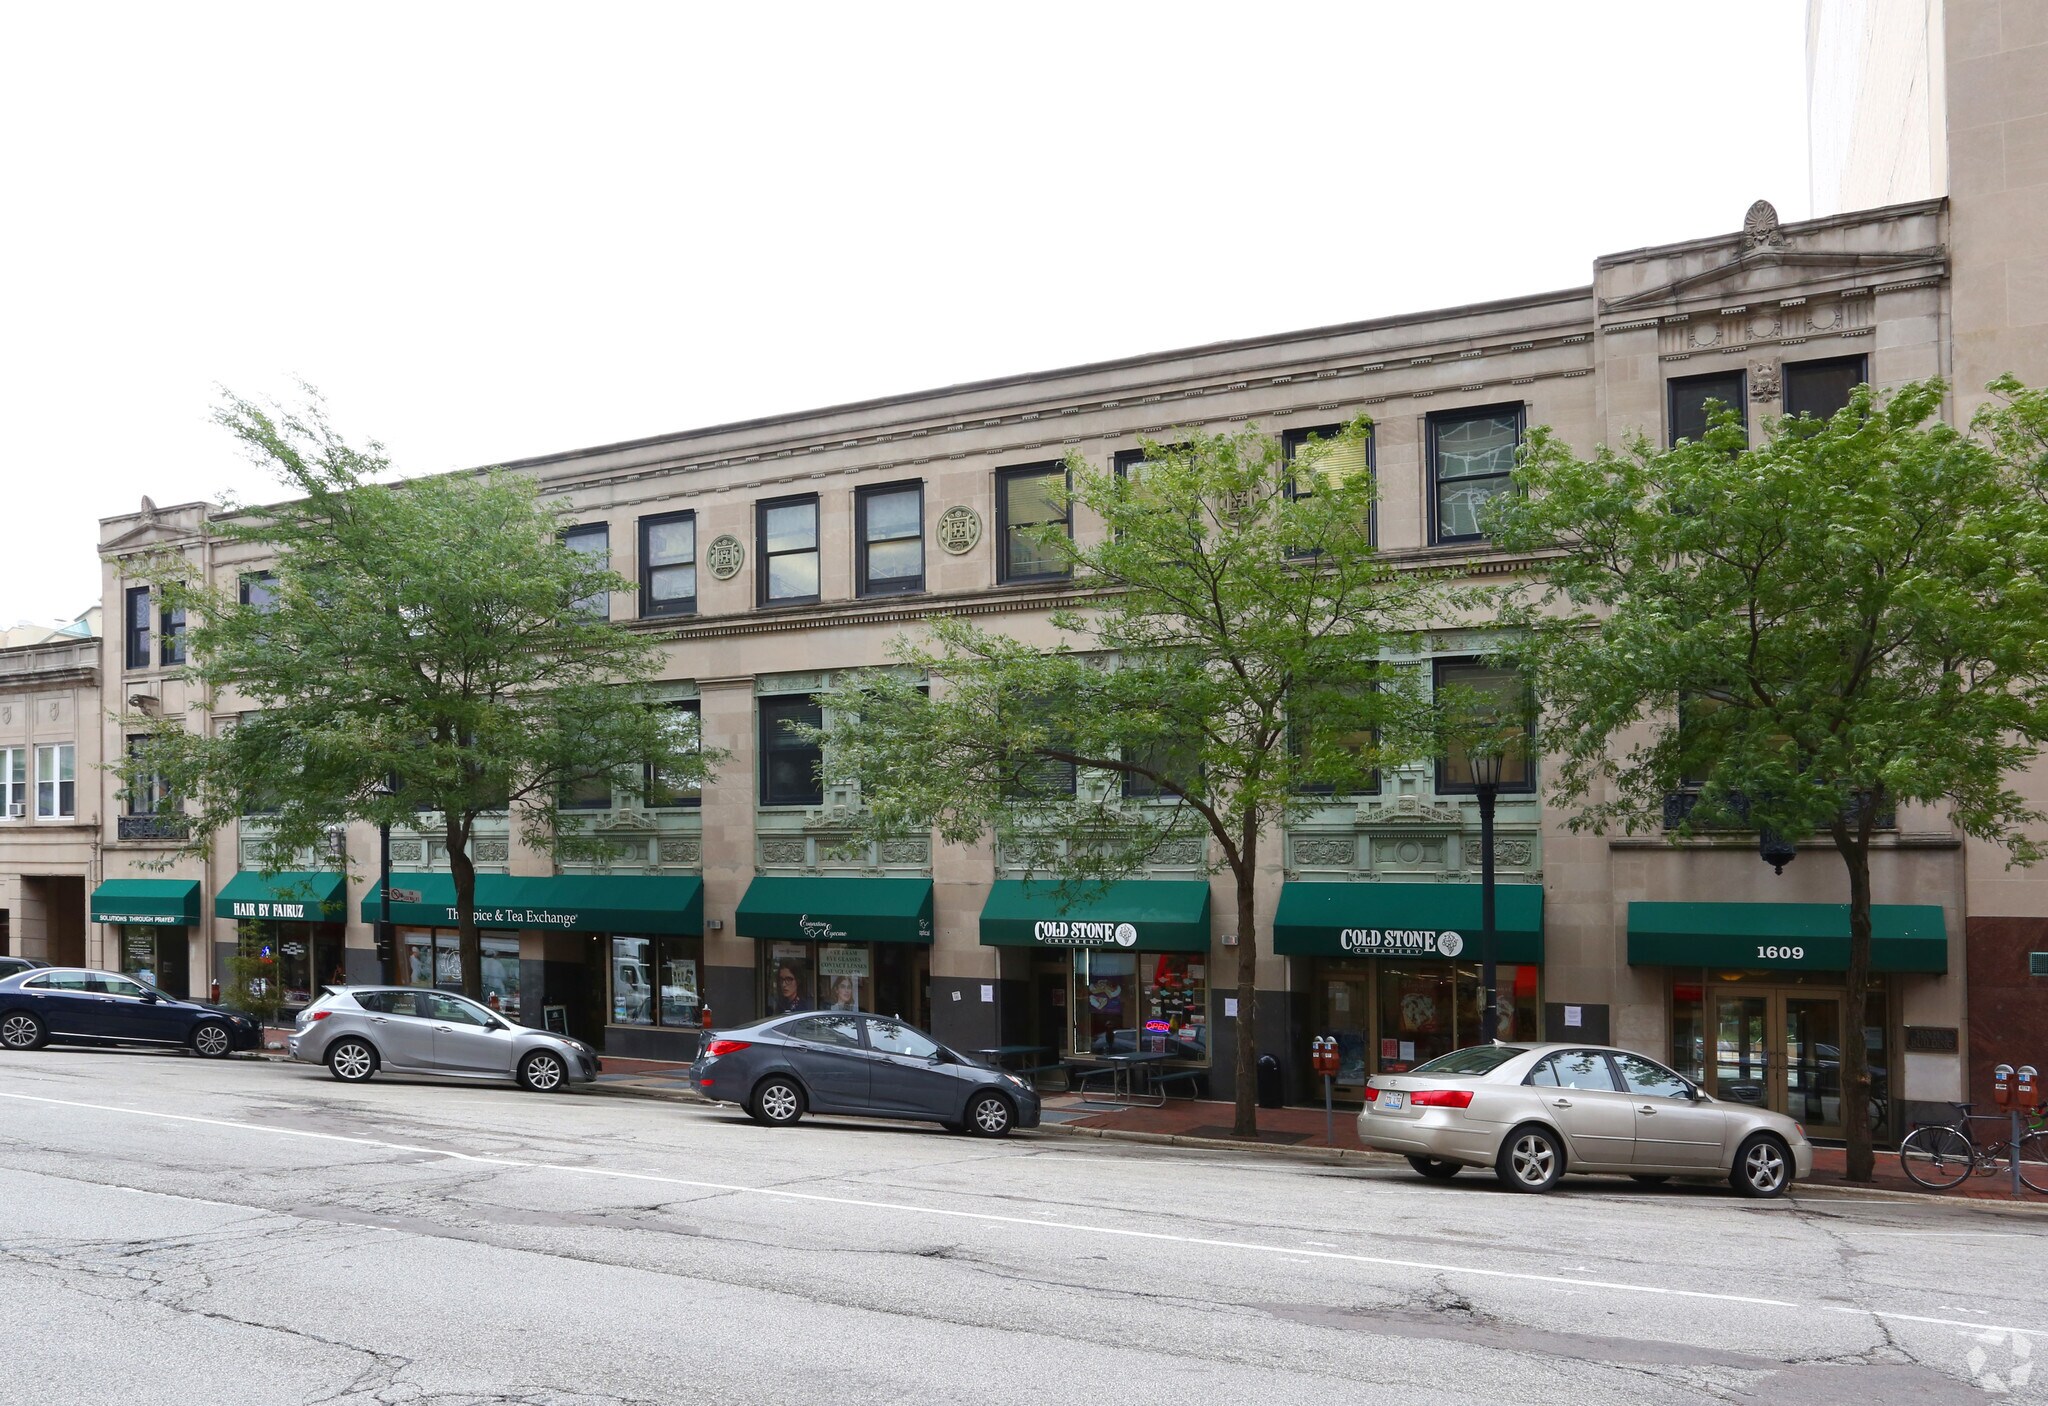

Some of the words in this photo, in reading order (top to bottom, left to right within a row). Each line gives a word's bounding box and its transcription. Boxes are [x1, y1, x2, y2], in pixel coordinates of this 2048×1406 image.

[233, 902, 256, 916] HAIR
[258, 903, 270, 917] BY
[273, 903, 304, 918] FAIRUZ
[446, 907, 459, 920] Th
[473, 909, 493, 924] pice
[505, 909, 524, 922] Tea
[526, 910, 576, 928] Exchange
[99, 914, 128, 922] SOLUTIONS
[128, 915, 154, 923] THROUGH
[799, 914, 827, 928] Evanston
[823, 923, 847, 938] Eyecare
[1034, 921, 1069, 941] COLD
[1070, 922, 1115, 943] STONE
[1340, 929, 1382, 950] COLD
[1384, 930, 1437, 952] STONE
[1757, 945, 1805, 960] 1609
[1145, 1022, 1171, 1032] OPEN
